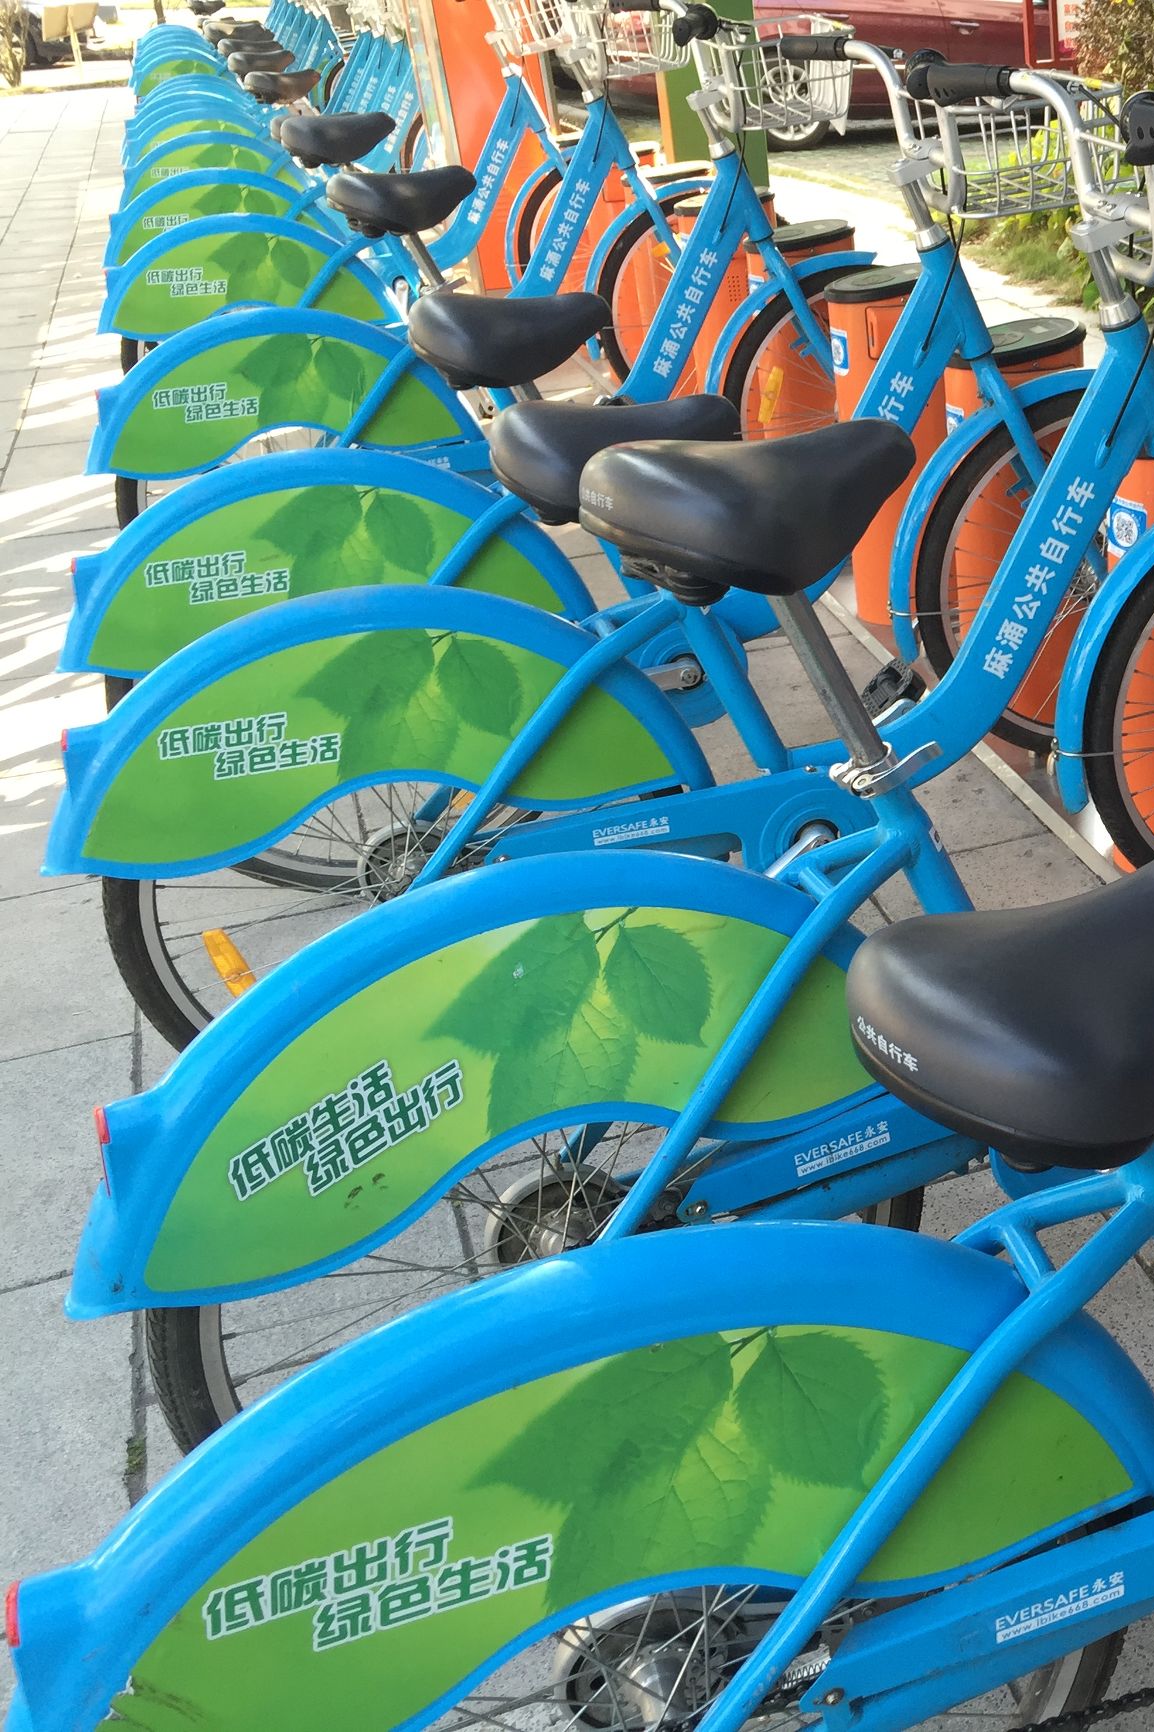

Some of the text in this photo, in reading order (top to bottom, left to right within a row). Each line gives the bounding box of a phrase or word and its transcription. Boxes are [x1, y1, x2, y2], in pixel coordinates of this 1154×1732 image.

[540, 179, 591, 282] 麻涌公共自行车
[146, 267, 203, 285] 低碳出行
[171, 280, 228, 297] 绿色生活
[653, 248, 718, 378] 麻涌公共自行车
[153, 382, 228, 409] 低碳出行
[185, 397, 259, 423] 绿色生活
[145, 551, 247, 587] 低碳出行
[189, 568, 290, 605] 绿色生活
[982, 476, 1095, 680] 麻涌公共自行车
[157, 712, 288, 760] 低碳出行
[214, 733, 341, 781] 绿色生活
[592, 820, 648, 838] EVERSAFE
[857, 1015, 919, 1072] 公共自行车
[228, 1059, 394, 1201] 低碳生活
[304, 1059, 463, 1196] 绿色出行
[793, 1130, 863, 1166] EVERSAFE
[203, 1516, 453, 1640] 低碳出行
[313, 1534, 553, 1652] 绿色生活
[995, 1571, 1125, 1631] EVERSAFE 永安
